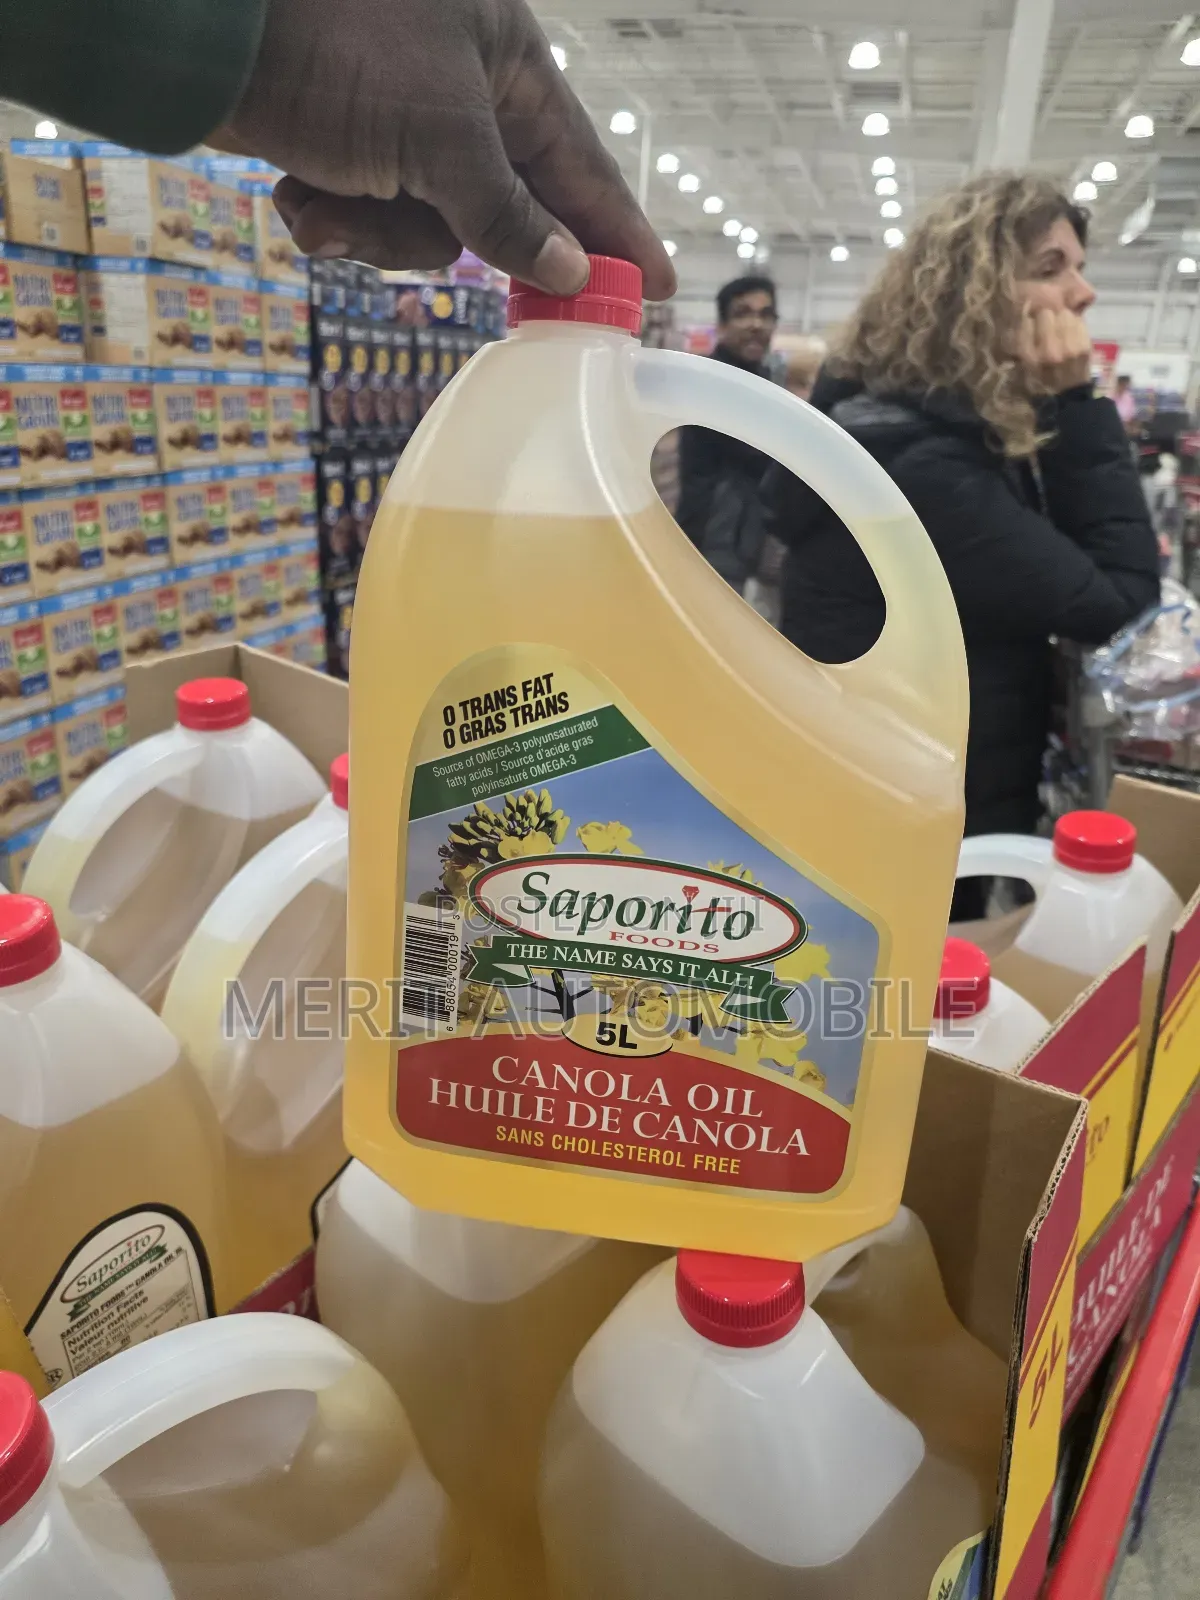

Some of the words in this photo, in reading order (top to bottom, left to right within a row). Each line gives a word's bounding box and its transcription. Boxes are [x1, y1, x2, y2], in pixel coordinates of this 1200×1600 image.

[458, 685, 517, 722] TRANS
[522, 672, 554, 702] FAT
[460, 712, 507, 744] GRAS
[510, 691, 570, 728] TRANS
[432, 762, 464, 778] Source
[465, 756, 476, 768] of
[476, 742, 521, 765] OMEGA-3
[522, 716, 599, 752] polyunsaturated
[446, 774, 468, 789] fatty
[468, 764, 494, 782] acids
[500, 754, 535, 772] Source
[572, 735, 594, 752] gras
[471, 768, 530, 798] polyinsaturé
[530, 754, 577, 778] OMEGA-3
[516, 871, 755, 940] Saporito
[447, 935, 460, 972] 00019
[506, 943, 548, 960] THE
[552, 946, 616, 966] NAME
[622, 954, 673, 974] SAYS
[678, 961, 700, 979] IT
[704, 968, 754, 990] ALL!
[609, 930, 720, 954] FOODS
[446, 976, 456, 1012] 88054
[595, 1022, 638, 1050] 5L
[492, 1056, 672, 1106] CANOLA
[687, 1084, 764, 1118] OIL
[428, 1077, 554, 1124] HUILE
[564, 1100, 621, 1134] DE
[632, 1110, 811, 1156] CANOLA
[496, 1126, 544, 1148] SANS
[552, 1136, 686, 1168] CHOLESTEROL
[694, 1154, 742, 1174] FREE
[76, 1234, 150, 1294] Saporito
[68, 1308, 114, 1347] Nutrition
[1030, 1321, 1065, 1431] 5L
